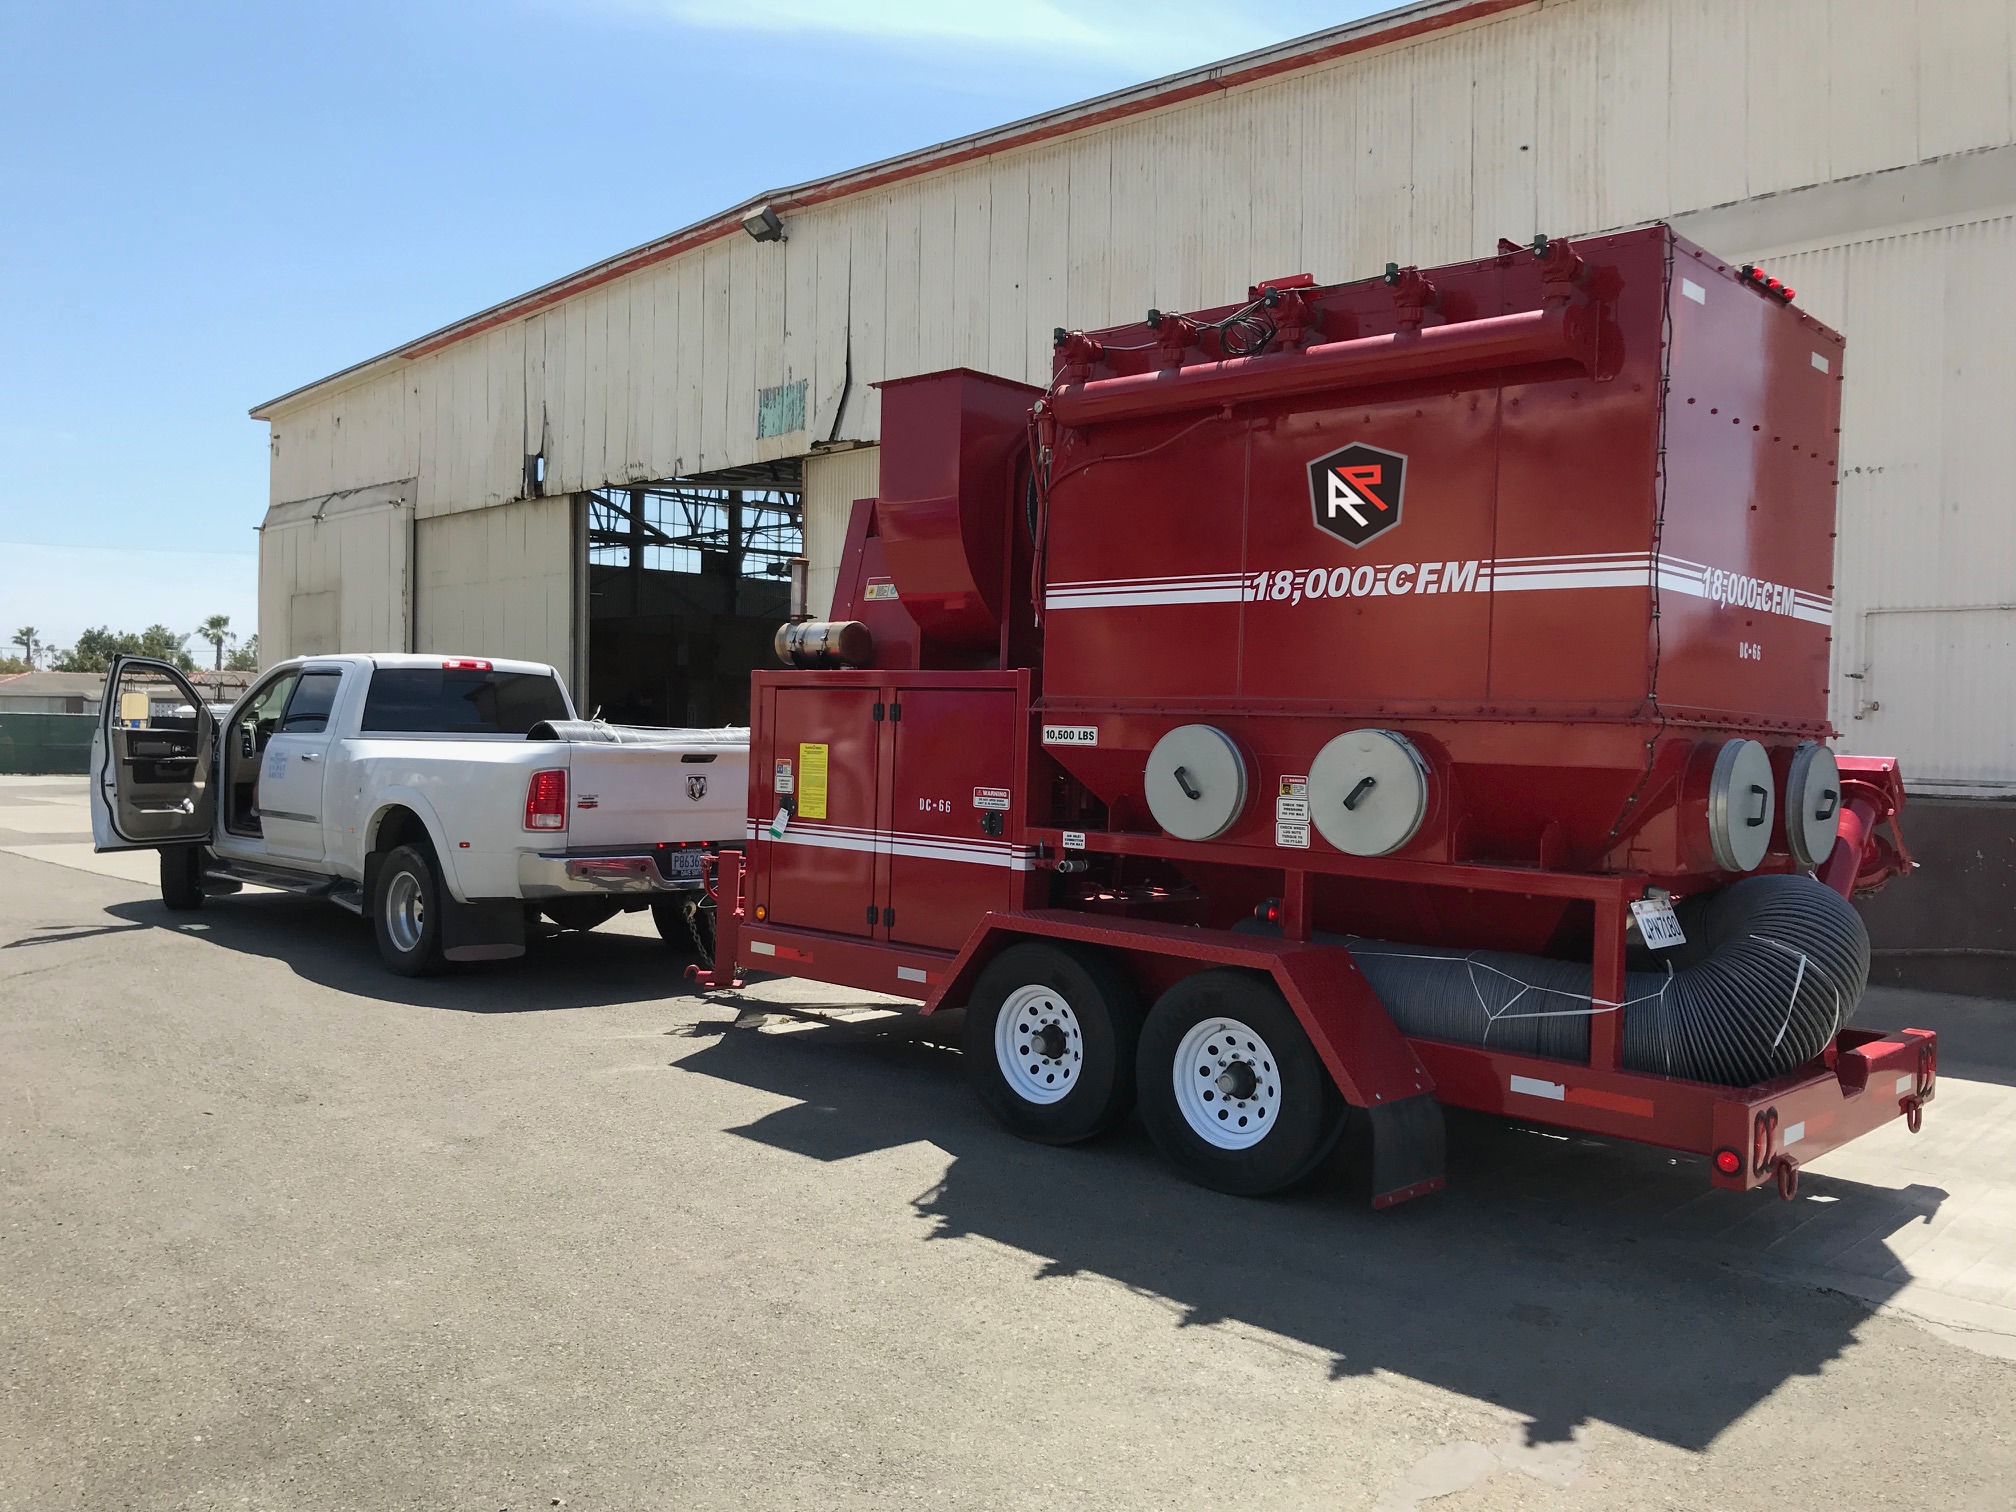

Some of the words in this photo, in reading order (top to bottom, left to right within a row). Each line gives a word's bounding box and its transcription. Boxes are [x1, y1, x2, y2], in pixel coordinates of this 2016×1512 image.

[1252, 565, 1375, 607] 18,000
[1386, 560, 1479, 595] CFM
[1702, 566, 1758, 609] 18,000
[1761, 581, 1795, 617] CFM
[1739, 641, 1761, 661] DC-66
[1045, 729, 1075, 742] 10,500
[1078, 730, 1095, 741] LBS
[982, 790, 1007, 798] WARNING
[919, 797, 951, 813] DC-66
[1642, 915, 1681, 941] 4PN7180
